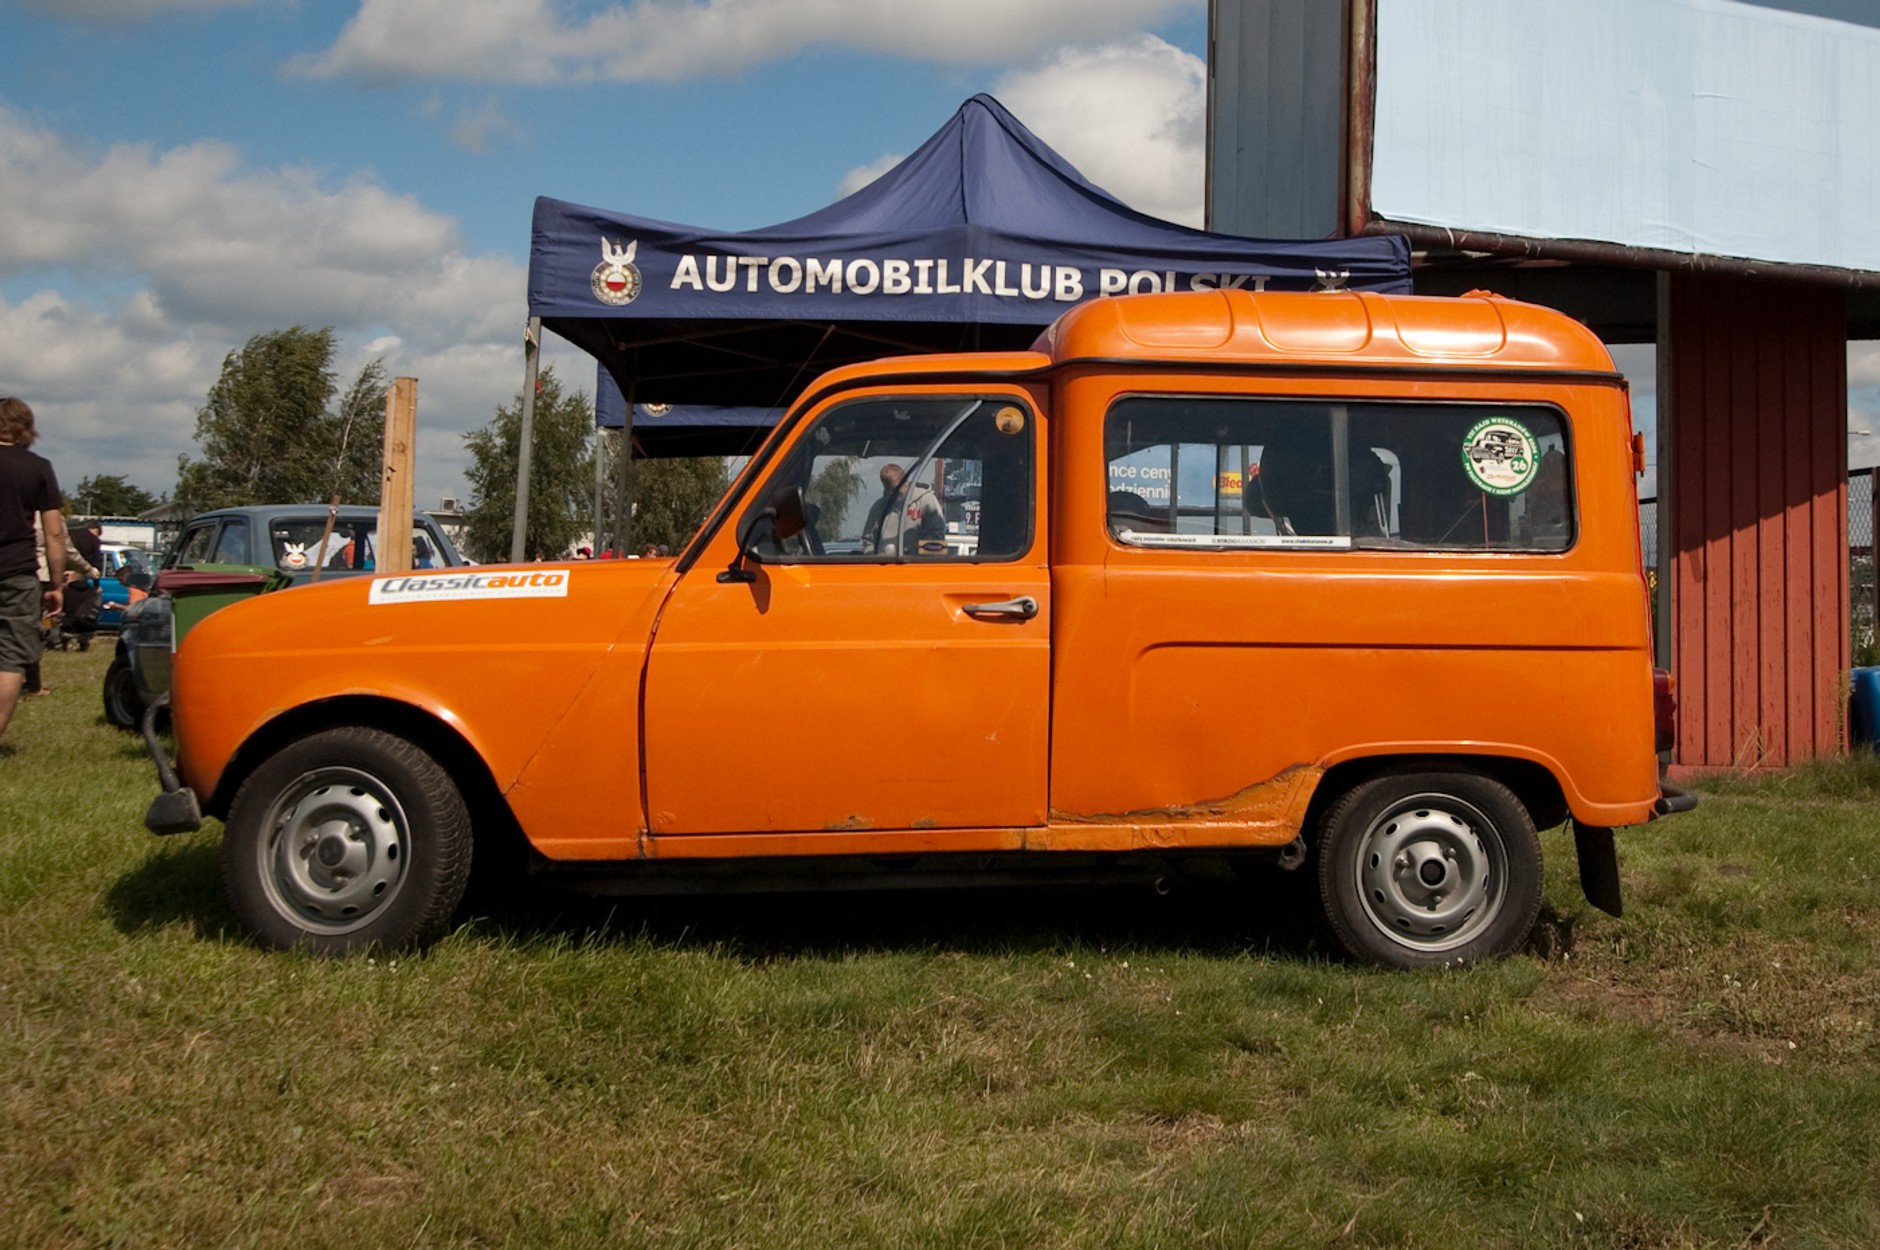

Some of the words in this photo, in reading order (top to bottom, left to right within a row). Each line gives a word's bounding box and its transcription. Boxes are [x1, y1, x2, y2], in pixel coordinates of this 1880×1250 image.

[670, 254, 1083, 301] AUTOMOBILKLUB
[1511, 459, 1526, 471] 26
[381, 574, 564, 593] Classicauto
